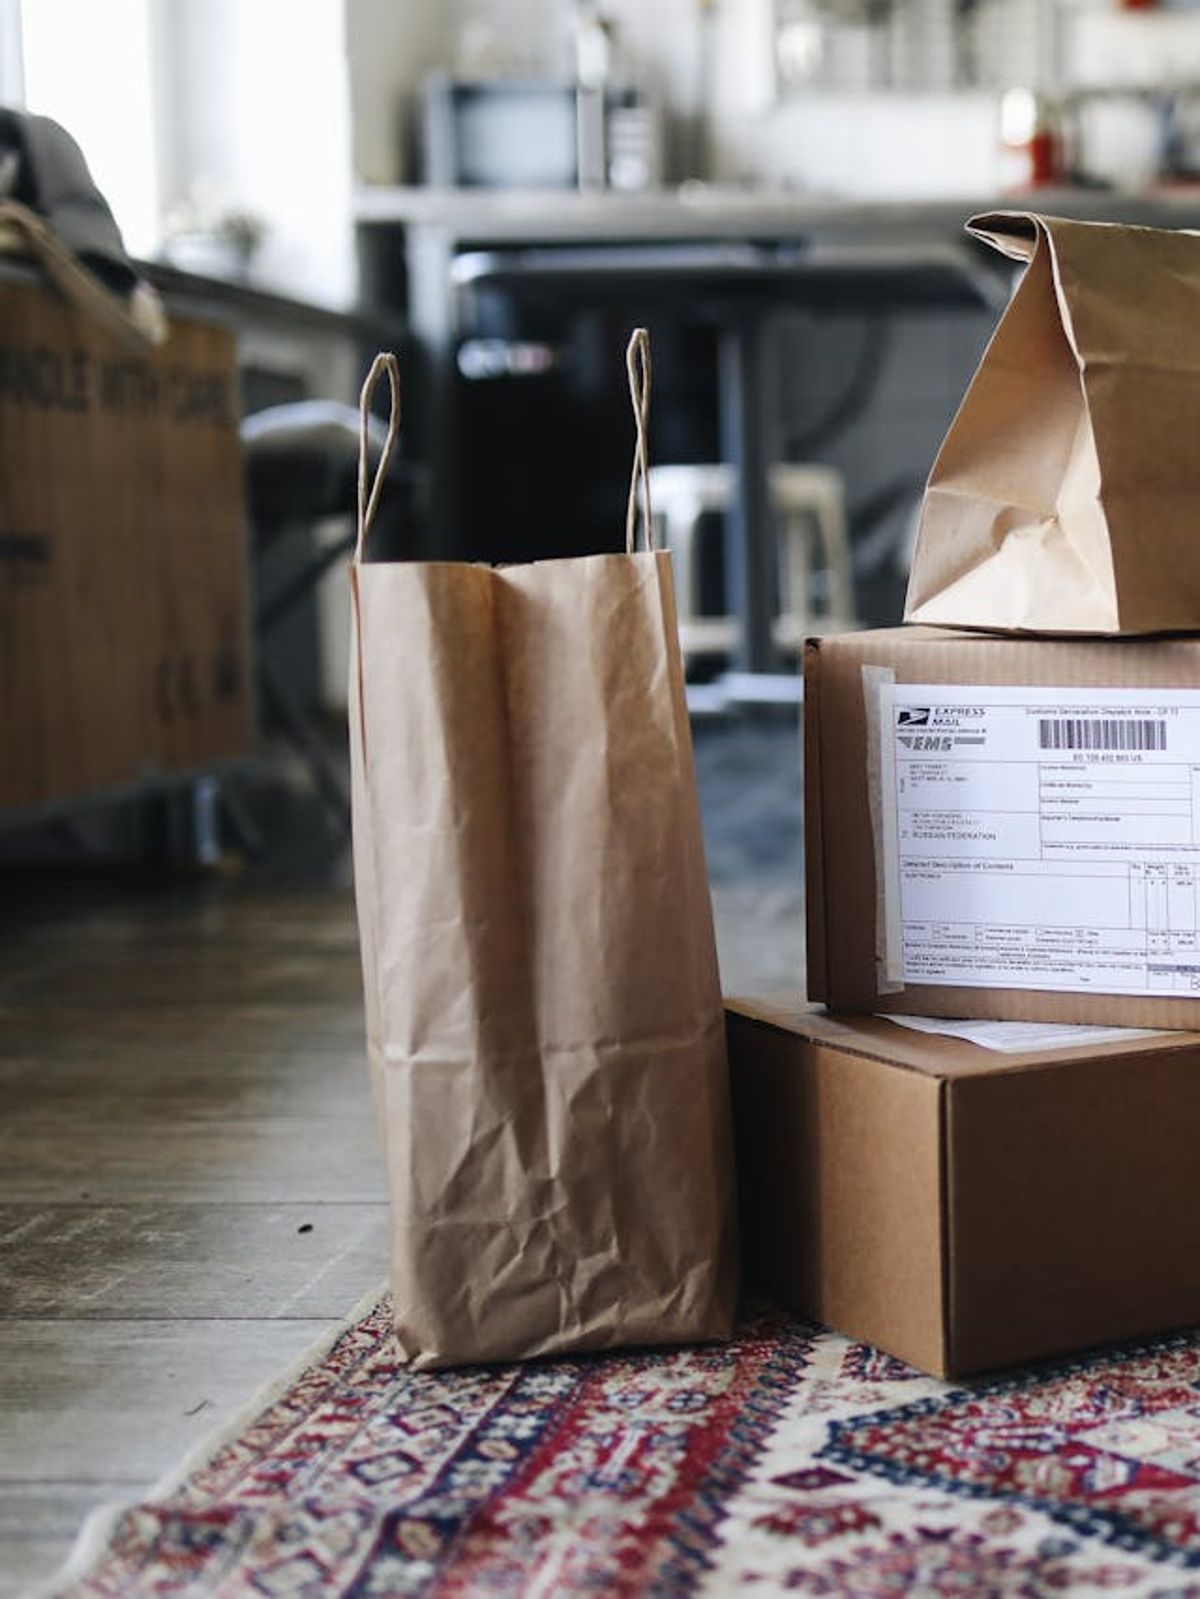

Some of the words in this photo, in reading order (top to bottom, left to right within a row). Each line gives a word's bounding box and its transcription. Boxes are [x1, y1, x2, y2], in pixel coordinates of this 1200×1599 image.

[934, 708, 986, 716] EXPRESS
[932, 718, 960, 726] MAIL
[913, 737, 952, 751] EMS
[912, 831, 946, 840] RUSSIAN
[946, 832, 997, 841] FEDERATION
